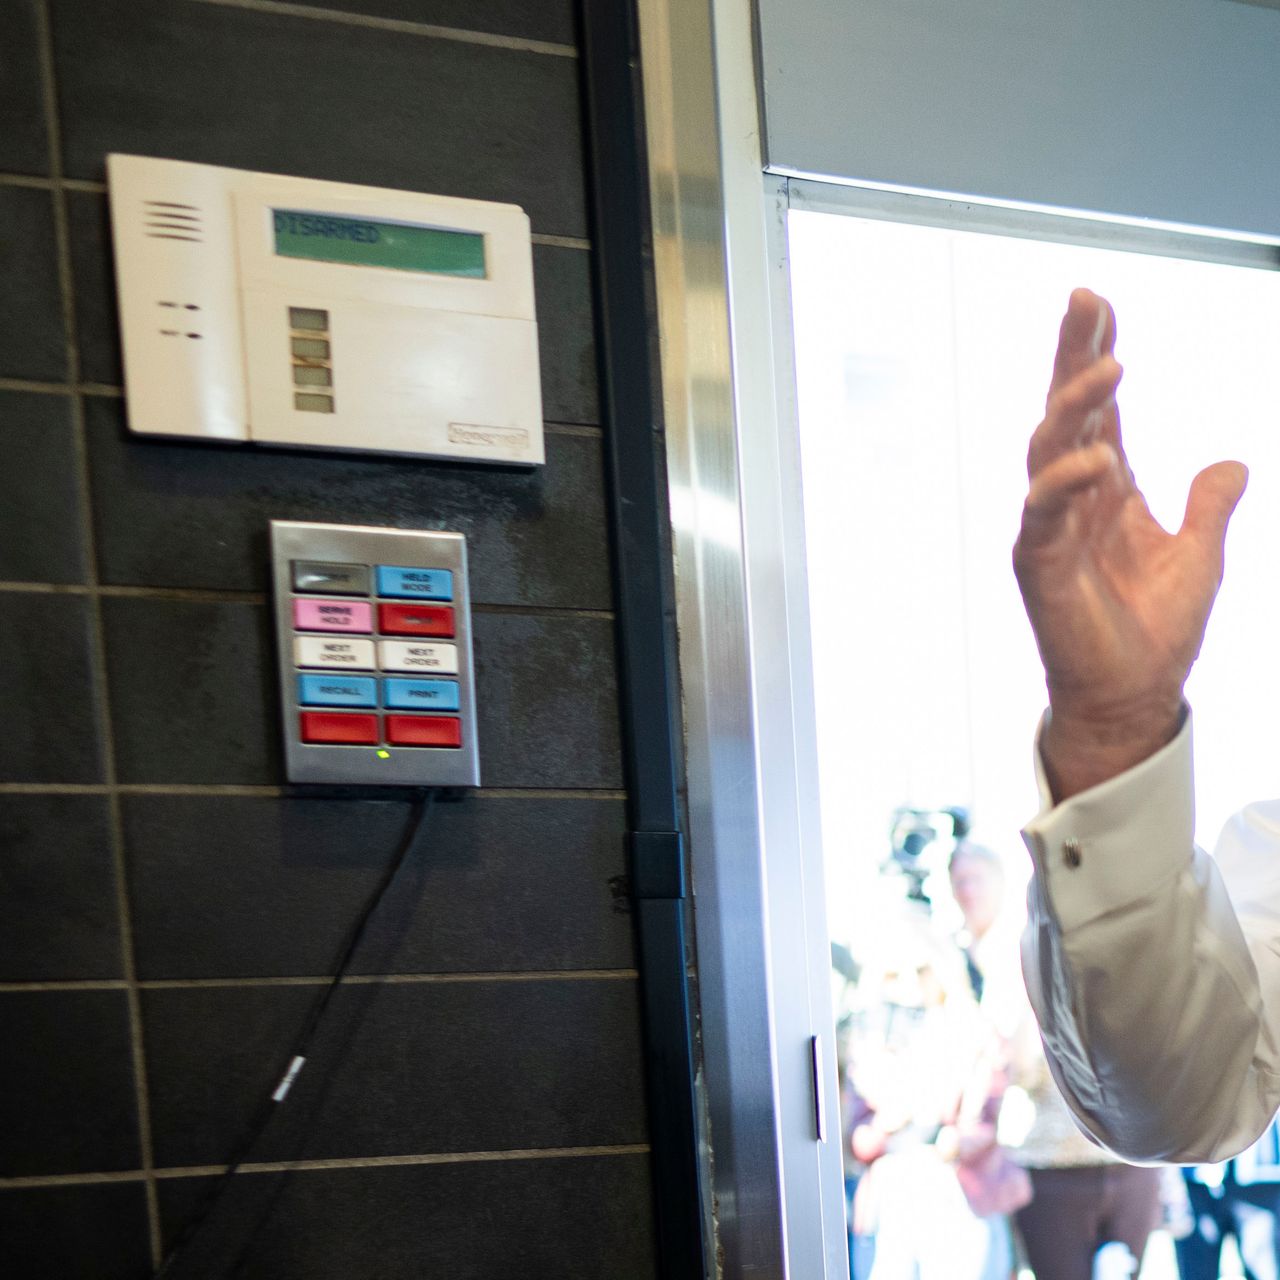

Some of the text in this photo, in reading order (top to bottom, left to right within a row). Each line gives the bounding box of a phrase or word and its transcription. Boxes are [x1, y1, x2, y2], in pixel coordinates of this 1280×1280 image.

[323, 643, 351, 652] NEXT
[407, 647, 435, 656] NEXT
[319, 653, 357, 662] ORDER
[403, 657, 441, 666] ORDER
[320, 685, 362, 696] RECALL
[407, 689, 440, 699] PRINT
